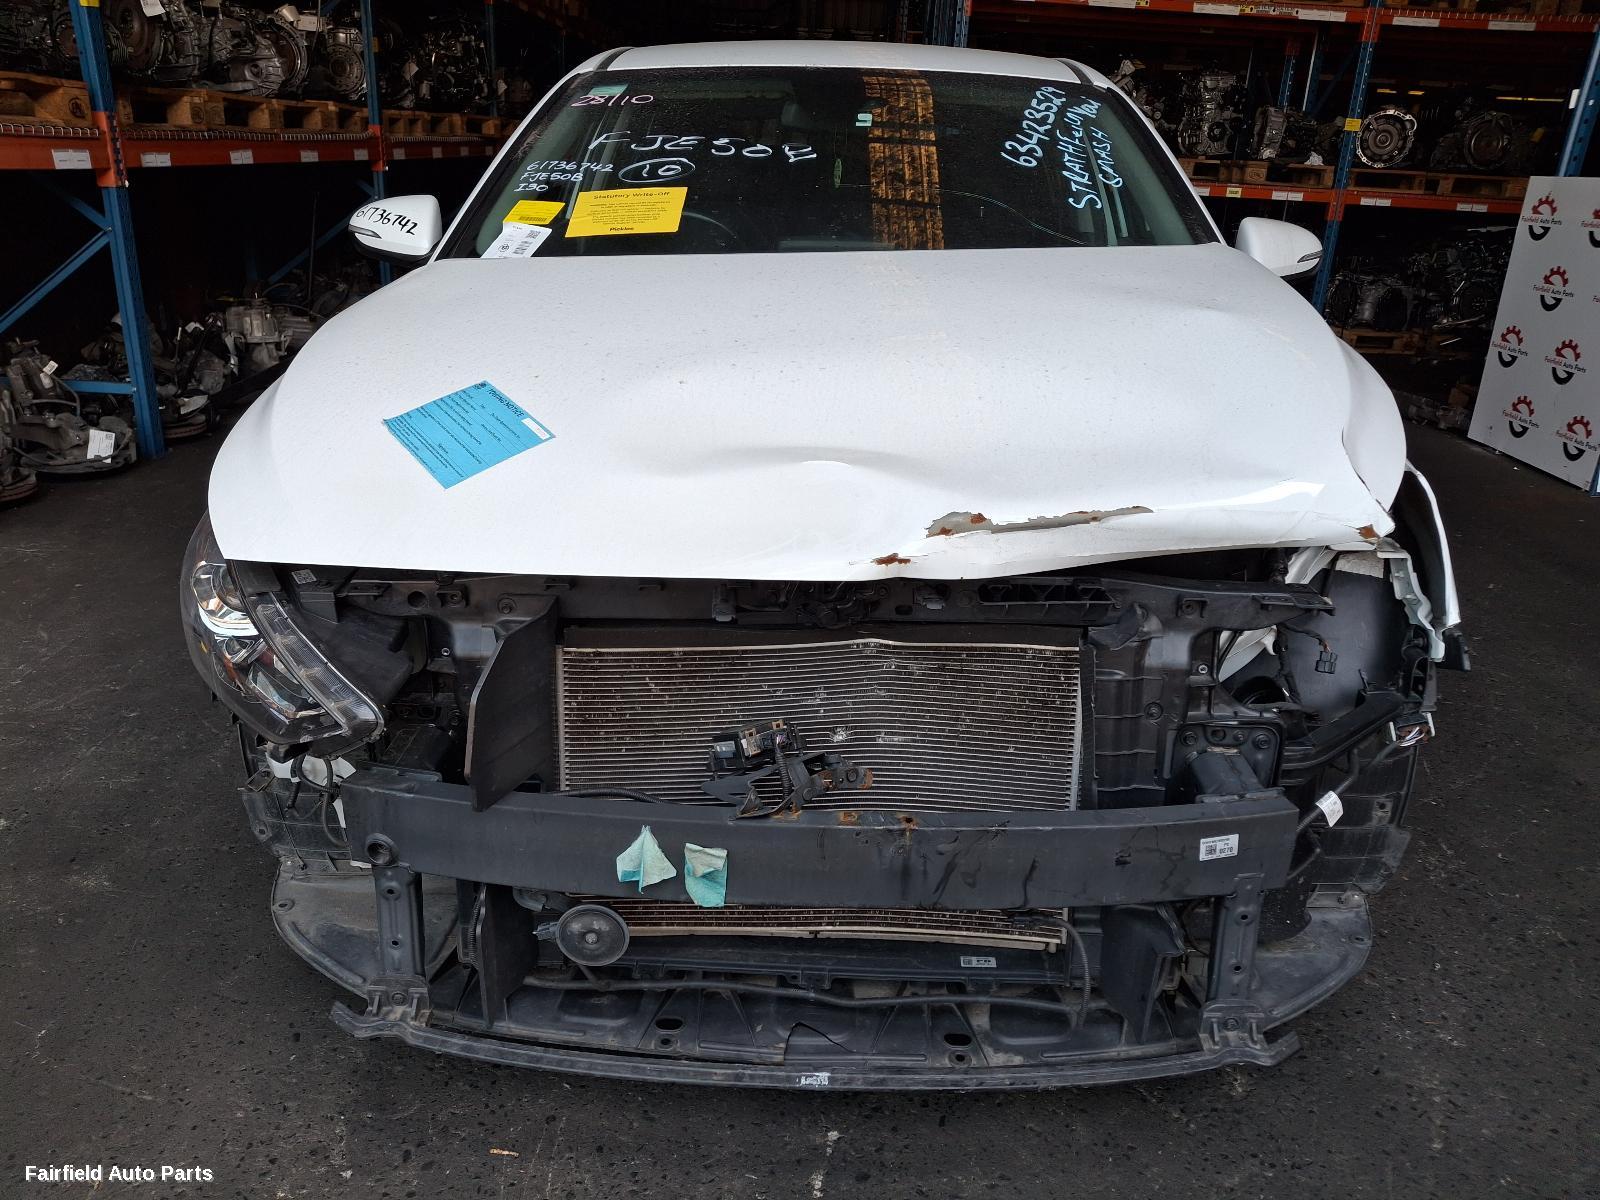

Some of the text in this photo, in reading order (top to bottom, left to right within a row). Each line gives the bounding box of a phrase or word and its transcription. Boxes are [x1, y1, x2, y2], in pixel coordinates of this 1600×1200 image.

[571, 93, 655, 107] 28/10
[1091, 130, 1123, 188] SMASH
[526, 161, 614, 173] 61736742
[519, 171, 584, 183] FJE50B
[593, 192, 630, 200] Statutory
[356, 206, 418, 236] 61736742
